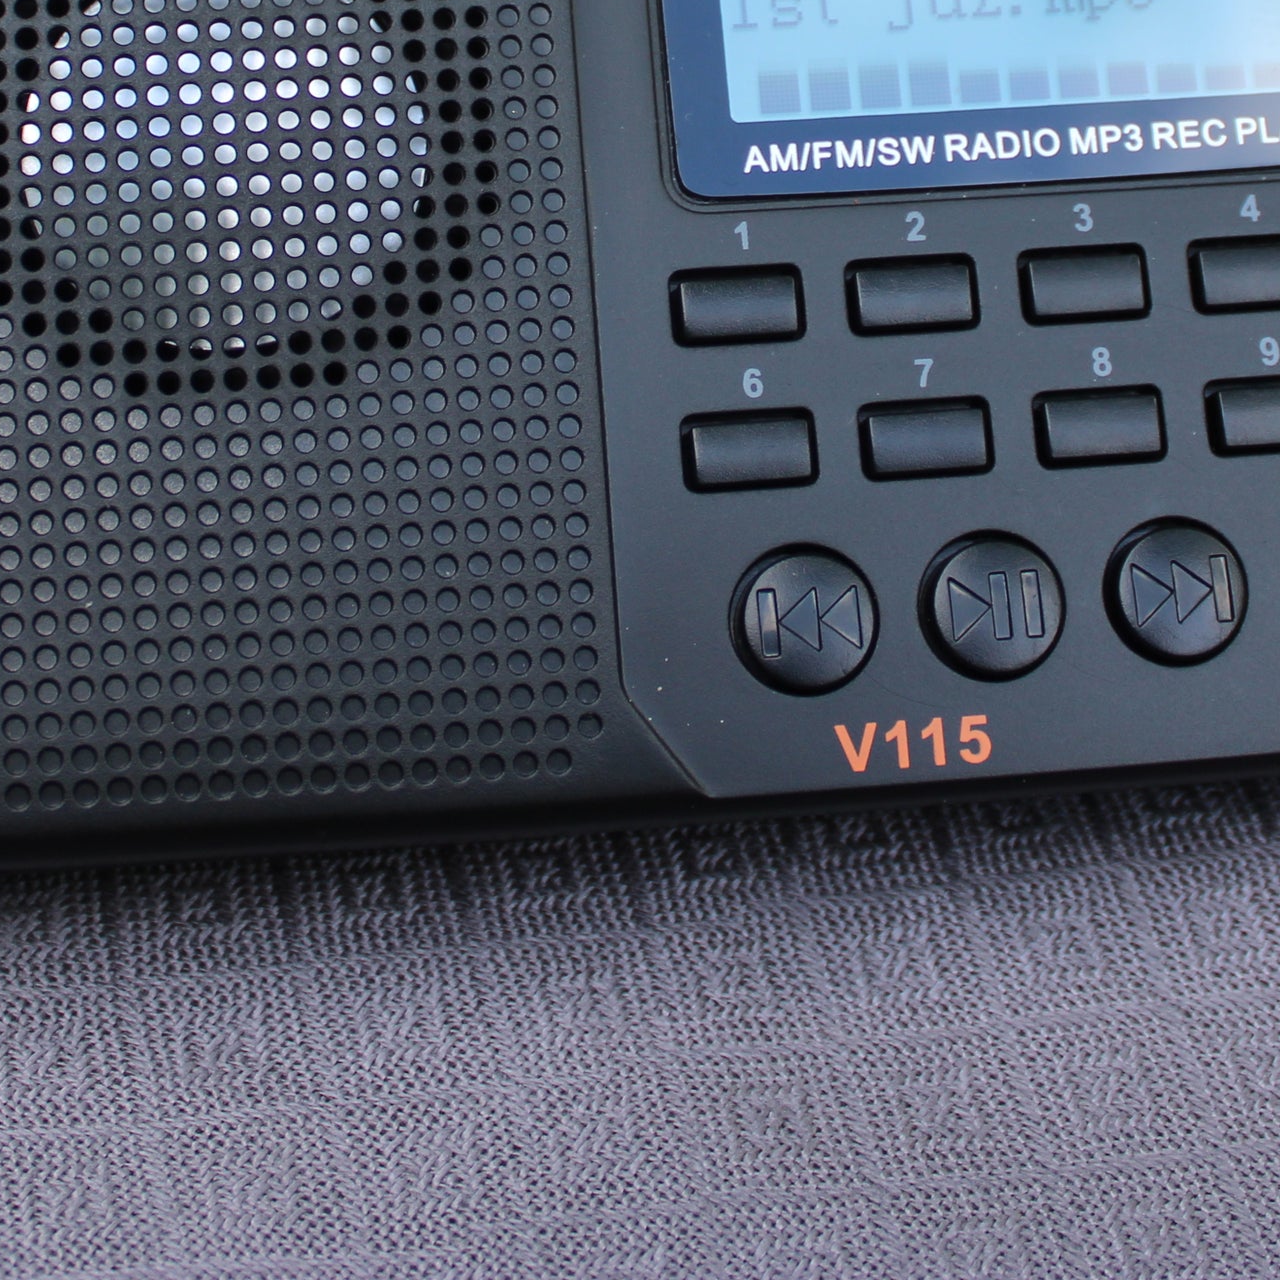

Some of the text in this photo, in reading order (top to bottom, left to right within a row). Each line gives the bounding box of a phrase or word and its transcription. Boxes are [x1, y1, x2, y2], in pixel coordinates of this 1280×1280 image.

[743, 135, 934, 173] AM/FM/SW
[944, 127, 1061, 162] RADIO
[1070, 121, 1144, 155] MP3
[1153, 117, 1226, 150] REC
[734, 221, 749, 250] 1
[906, 212, 927, 242] 2
[1073, 203, 1094, 232] 3
[1239, 194, 1261, 223] 4
[743, 368, 764, 398] 6
[914, 358, 934, 389] 7
[1092, 347, 1113, 378] 8
[1260, 337, 1280, 368] 9
[833, 714, 993, 772] V115
